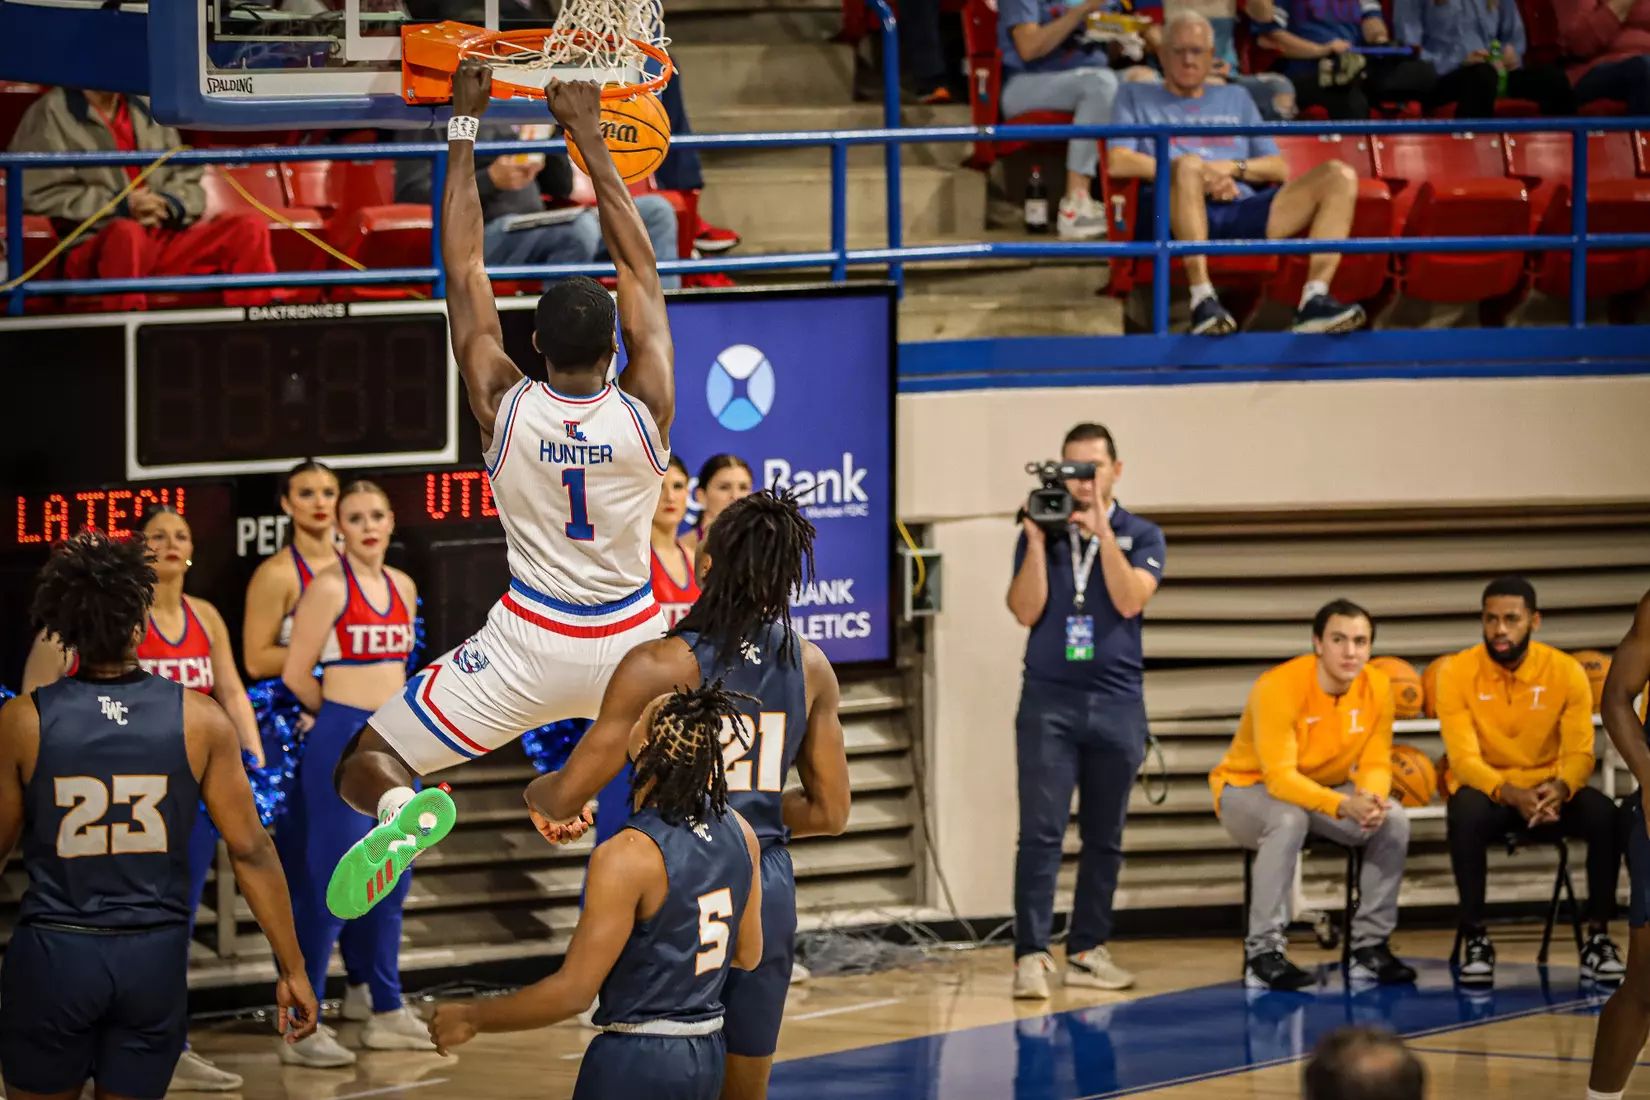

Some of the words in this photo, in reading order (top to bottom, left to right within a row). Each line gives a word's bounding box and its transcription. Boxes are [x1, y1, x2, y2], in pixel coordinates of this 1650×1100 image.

[206, 77, 253, 94] SPALDING
[599, 121, 638, 143] Wil
[249, 303, 346, 321] DAKTRONICS
[540, 439, 613, 465] HUNTER
[763, 451, 869, 507] Bank
[561, 467, 595, 541] 1
[345, 623, 416, 655] TECH
[97, 695, 129, 726] TWC
[707, 711, 787, 793] 21
[53, 774, 169, 859] 23
[694, 887, 734, 977] 5
